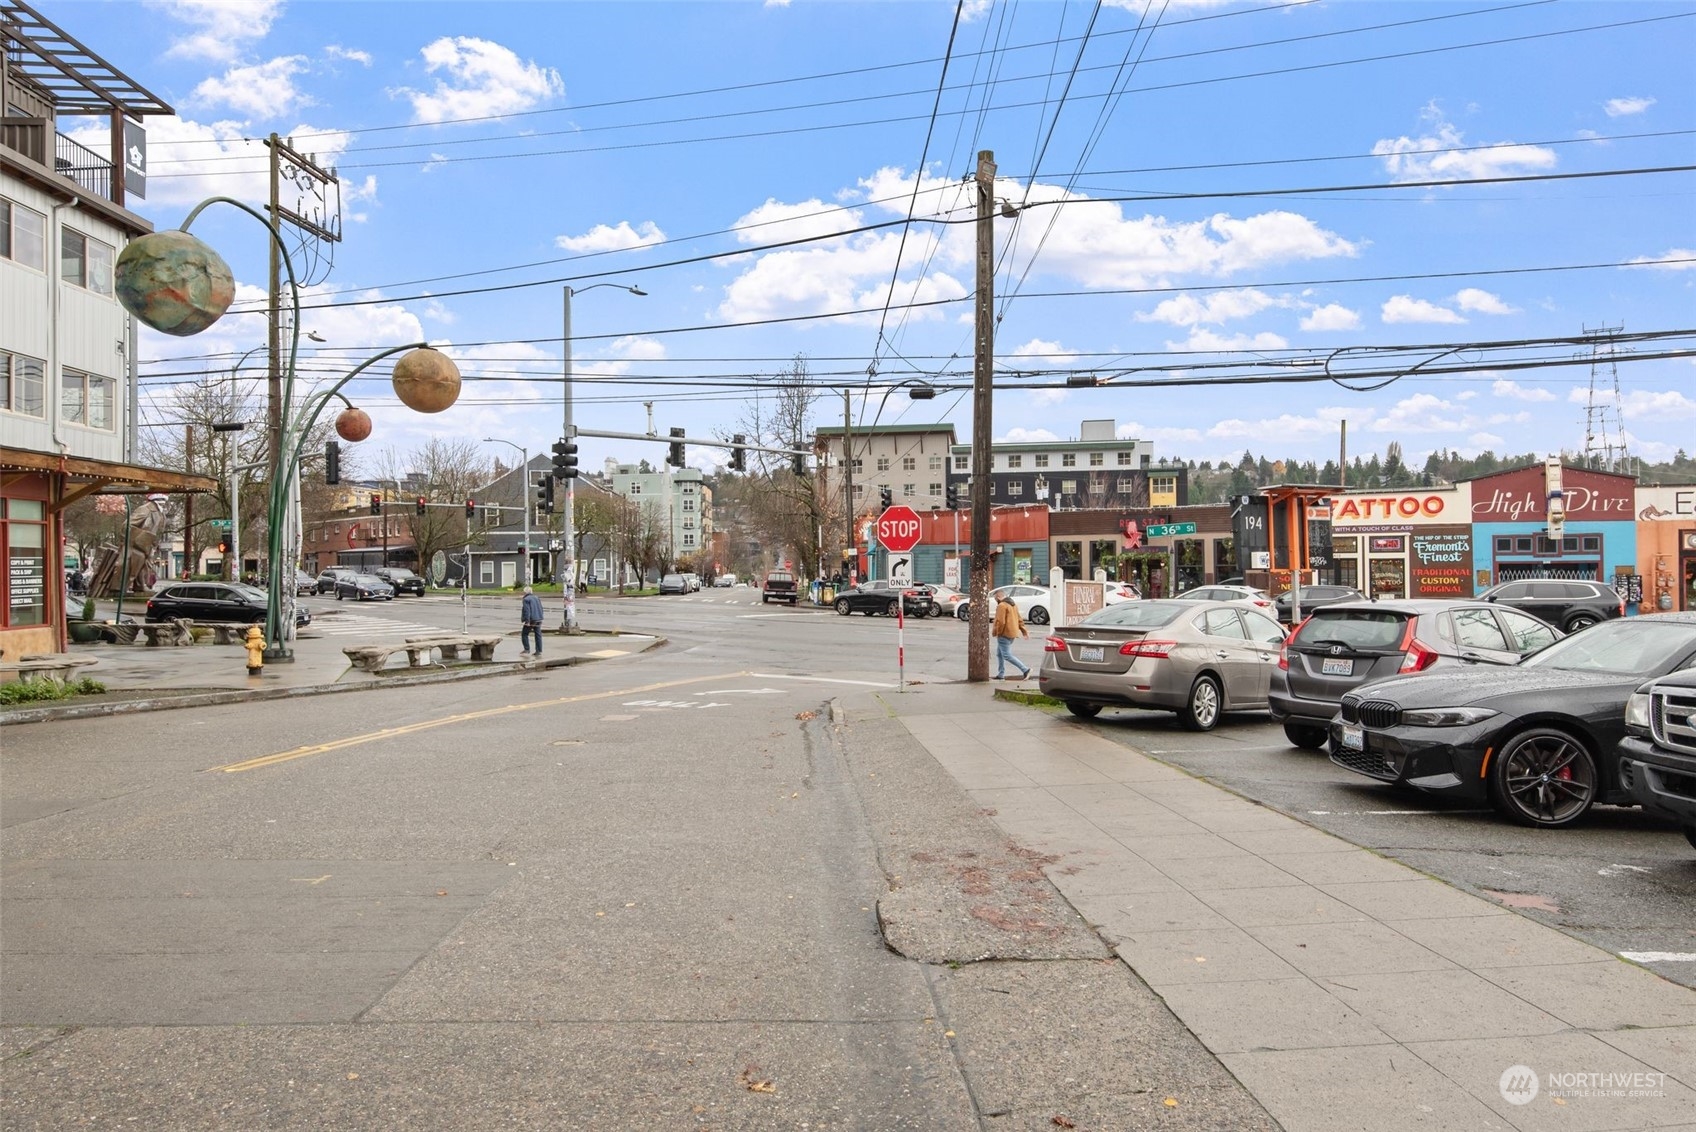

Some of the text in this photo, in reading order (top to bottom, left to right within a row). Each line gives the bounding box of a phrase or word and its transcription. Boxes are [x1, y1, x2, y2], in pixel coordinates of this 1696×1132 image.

[1472, 488, 1540, 521] High
[1675, 491, 1696, 515] E
[881, 520, 918, 538] STOP
[1245, 516, 1262, 530] 194
[1413, 540, 1470, 554] Fremont's
[1419, 552, 1462, 565] Finest
[1412, 568, 1472, 577] TRADITIONAL
[1421, 577, 1459, 585] CUSTOM
[1073, 586, 1095, 604] FUNERAL
[1077, 604, 1091, 614] HOME
